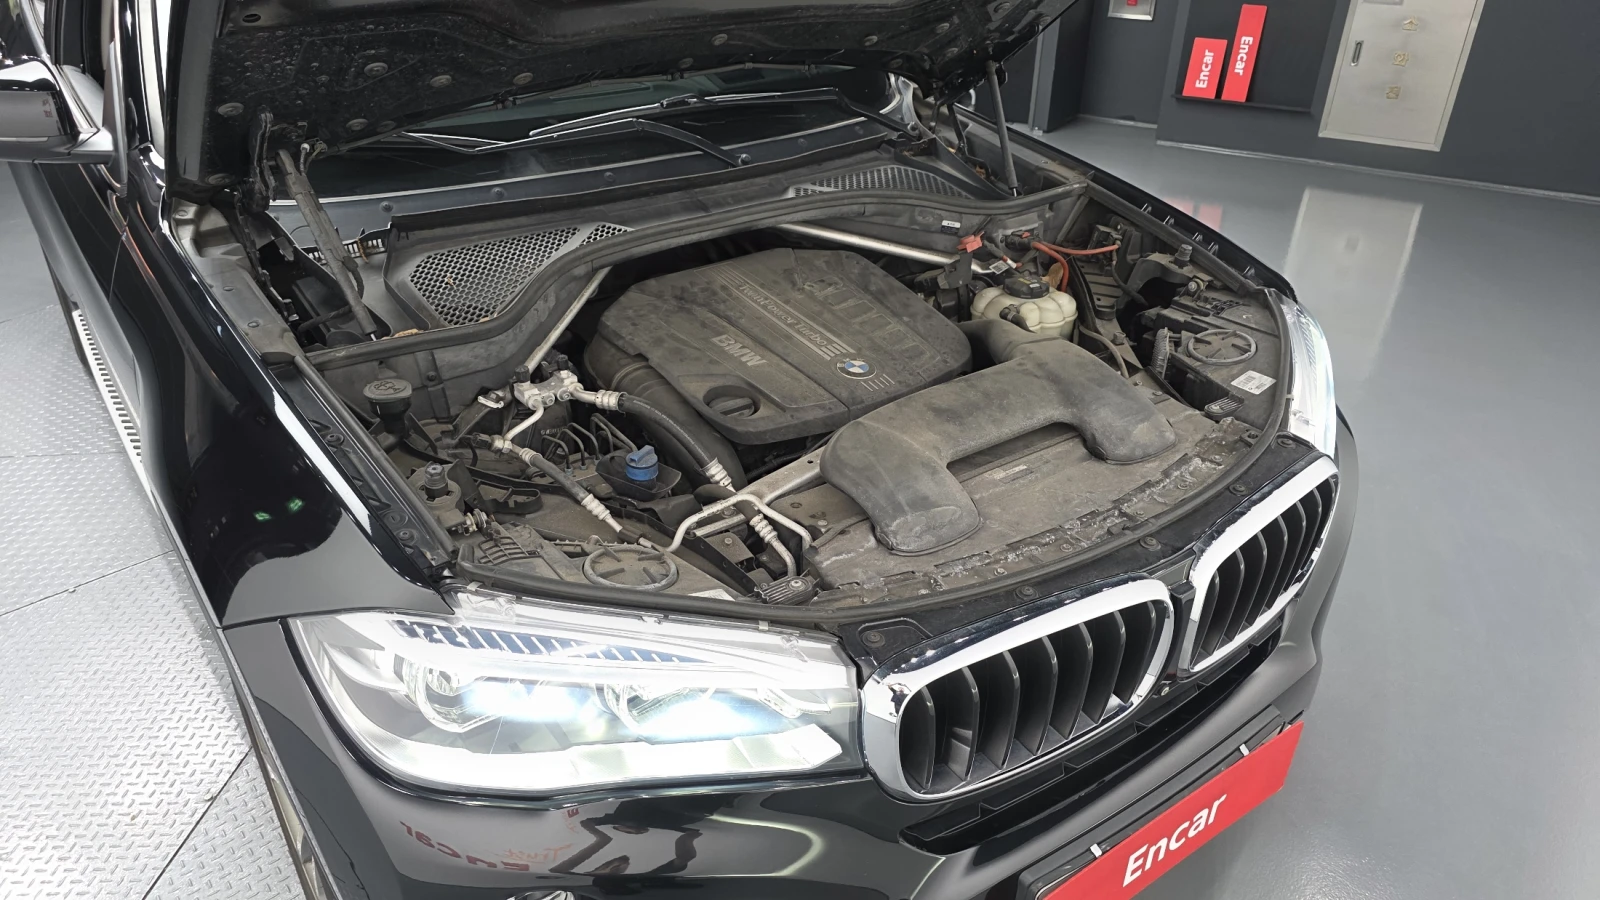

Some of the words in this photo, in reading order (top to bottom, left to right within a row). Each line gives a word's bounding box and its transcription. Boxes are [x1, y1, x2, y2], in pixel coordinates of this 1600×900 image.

[1195, 49, 1214, 88] Encar
[1234, 36, 1253, 76] Encar
[738, 283, 797, 324] TwinPower
[794, 322, 827, 346] Turbo
[711, 334, 767, 366] BMW
[1122, 793, 1227, 887] Encar
